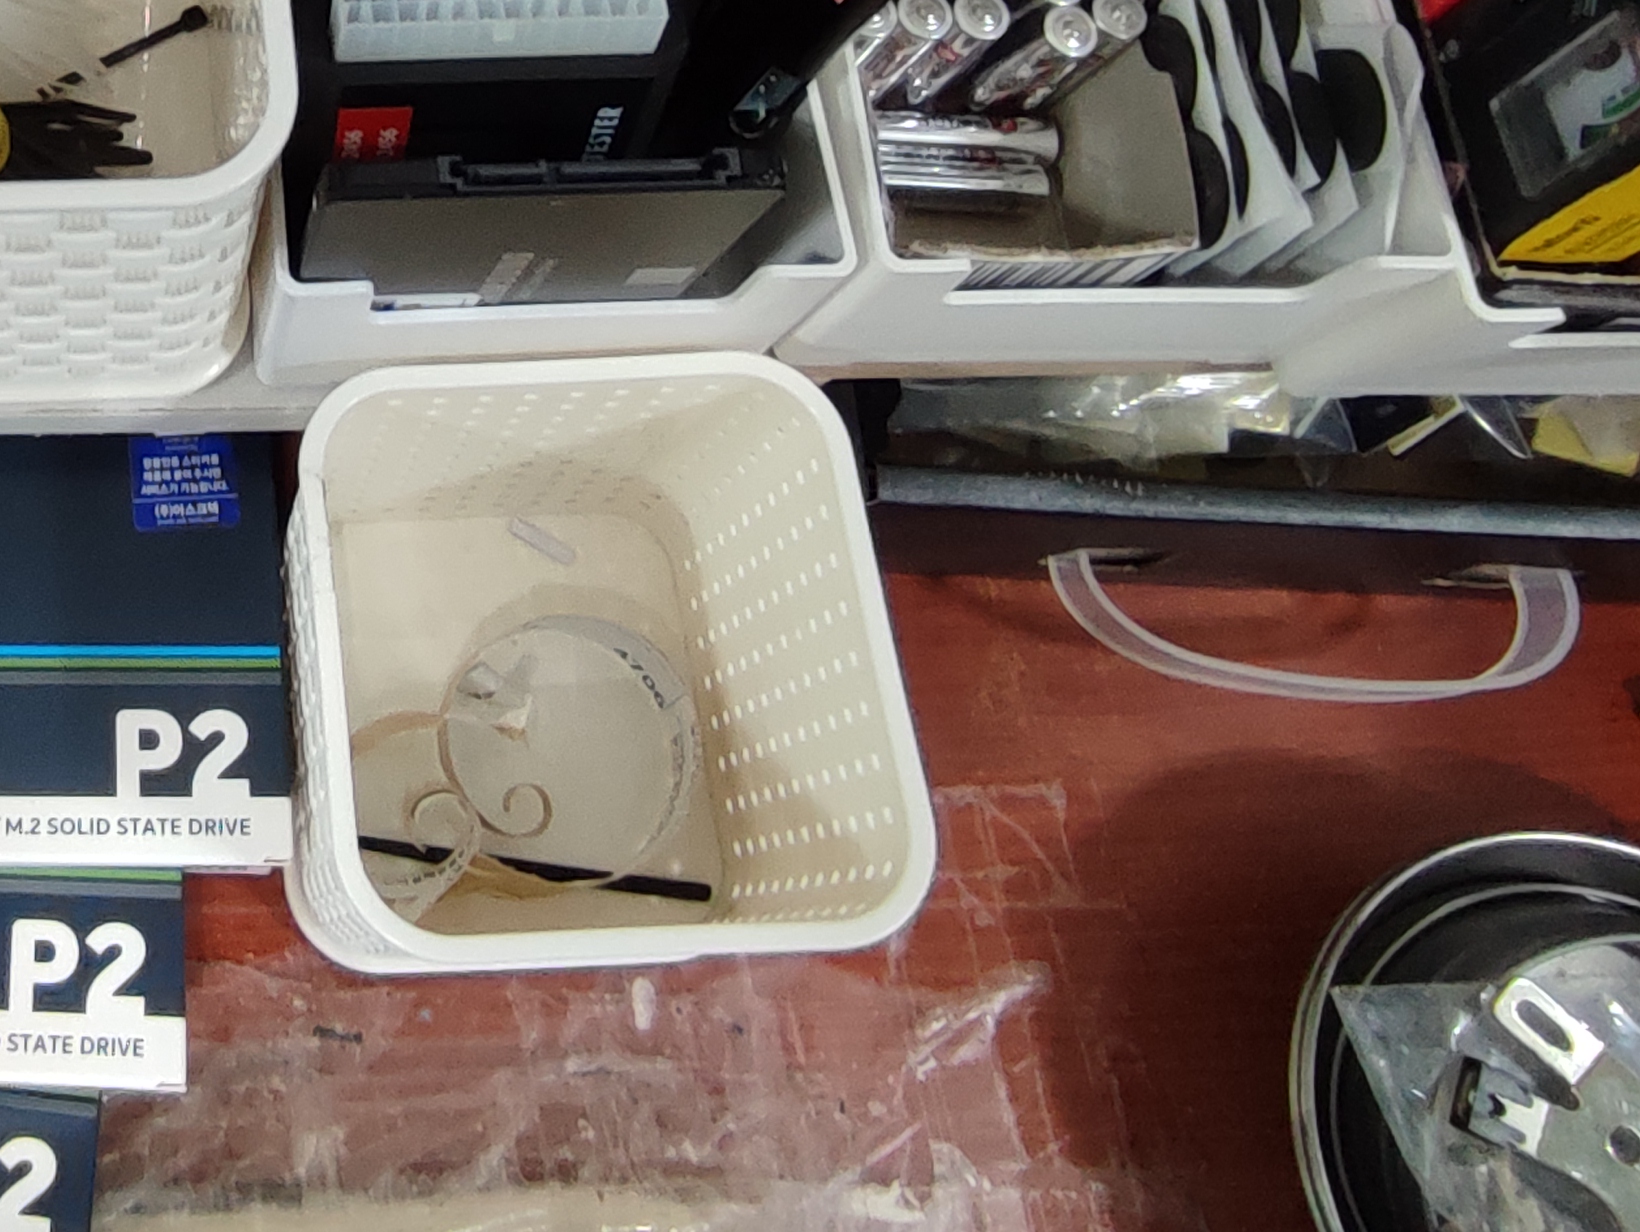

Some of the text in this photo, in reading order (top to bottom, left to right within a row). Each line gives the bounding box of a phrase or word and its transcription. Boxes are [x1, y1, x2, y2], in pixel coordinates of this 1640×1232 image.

[115, 708, 252, 797] P2
[5, 817, 42, 836] M.2
[46, 817, 111, 836] SOLID
[116, 817, 182, 836] STATE
[188, 817, 252, 836] DRIVE
[8, 918, 148, 1015] P2
[6, 1031, 74, 1055] STATE
[79, 1035, 146, 1058] DRIVE
